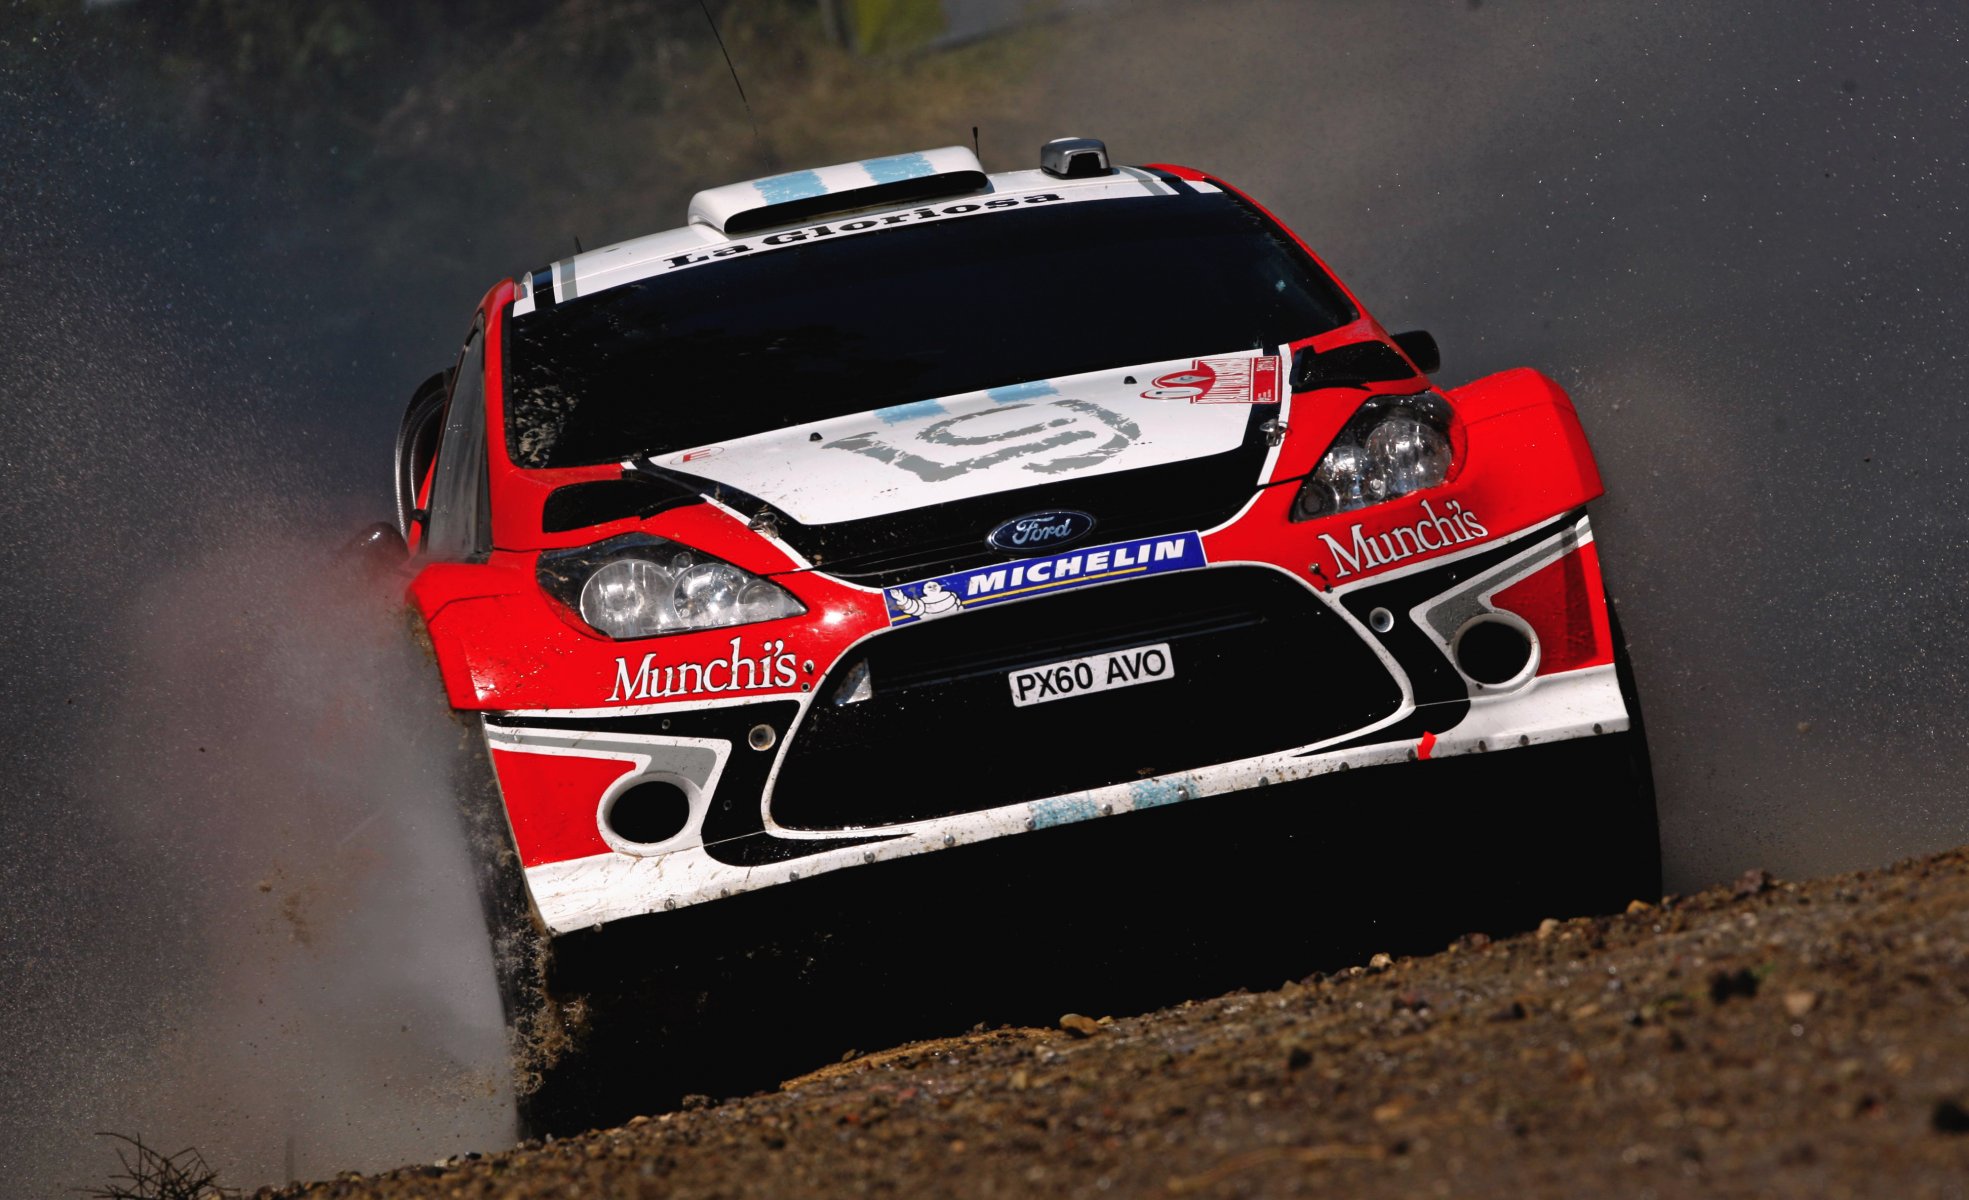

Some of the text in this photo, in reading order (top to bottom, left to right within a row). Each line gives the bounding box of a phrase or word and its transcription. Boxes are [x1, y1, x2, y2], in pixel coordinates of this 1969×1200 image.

[1011, 516, 1072, 545] Ford
[1318, 499, 1489, 579] Munchi's
[966, 538, 1186, 596] MICHELIN
[604, 636, 798, 702] Munchi's
[1015, 648, 1167, 702] PX60 AVO
